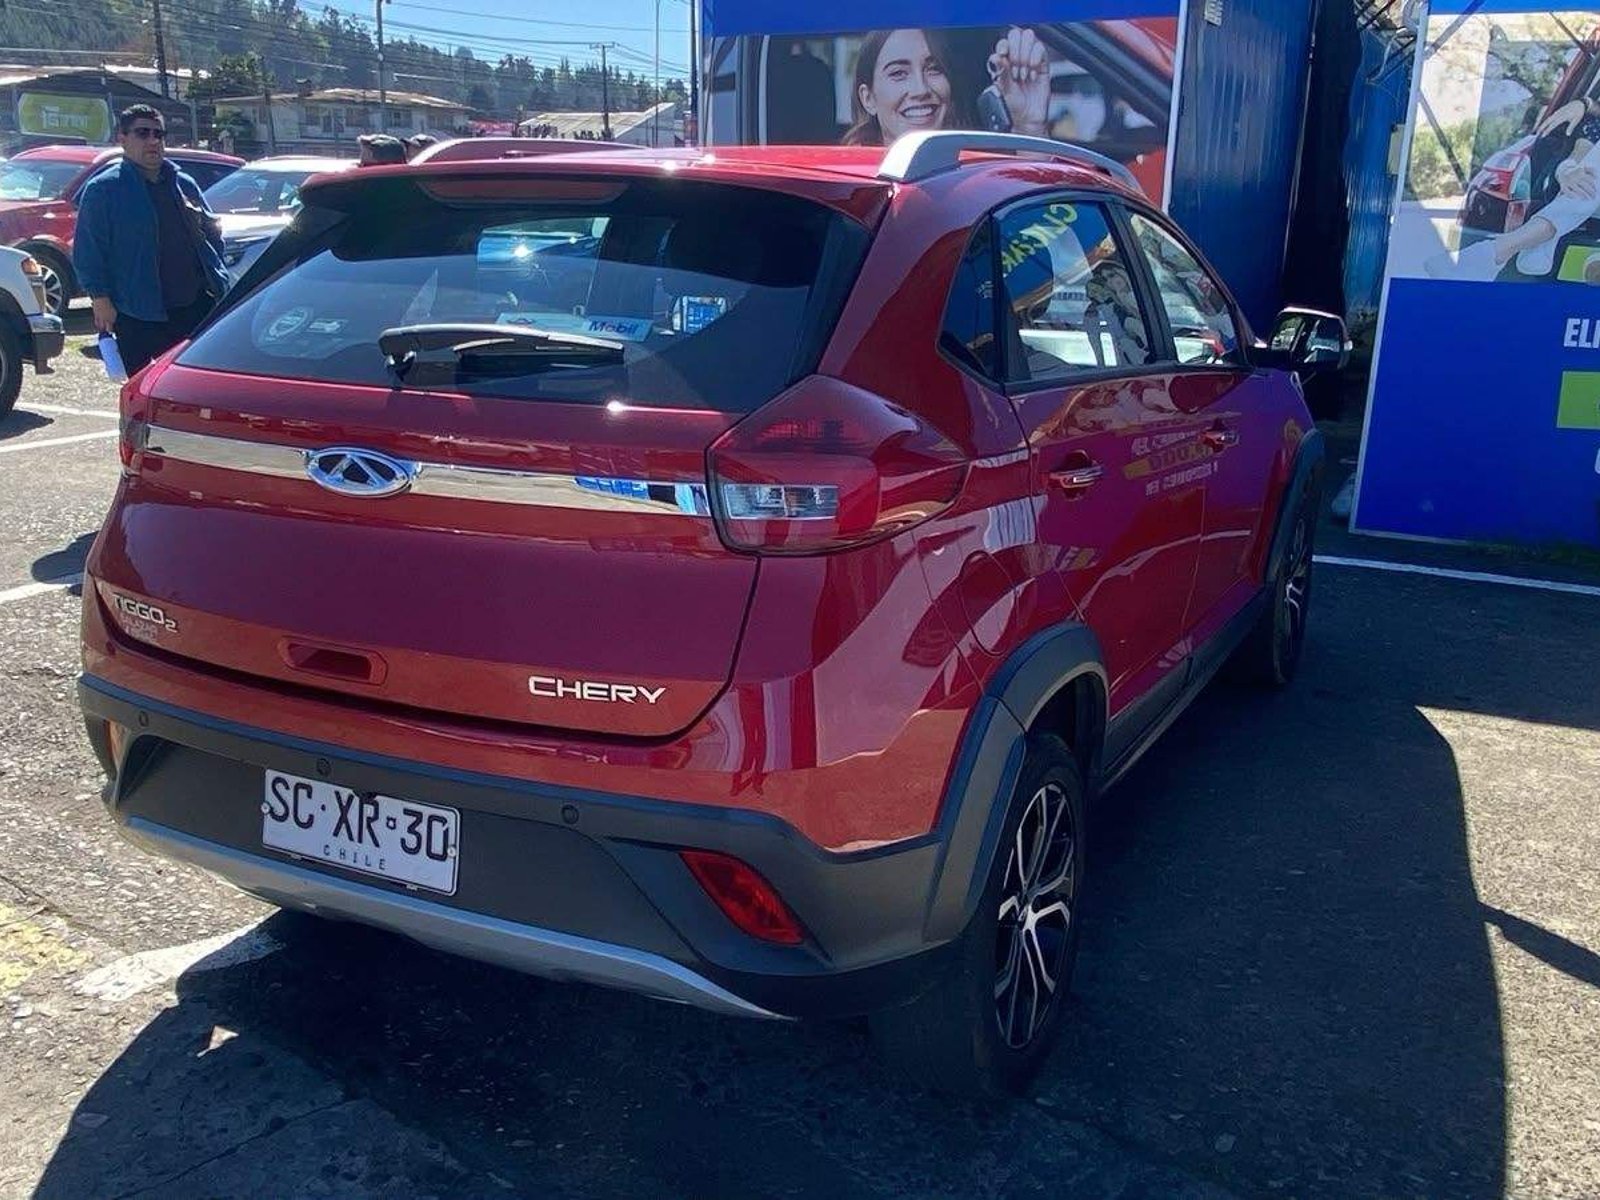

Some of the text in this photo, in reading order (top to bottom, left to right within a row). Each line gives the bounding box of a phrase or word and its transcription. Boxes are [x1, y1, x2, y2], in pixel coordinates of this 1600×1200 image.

[587, 320, 639, 335] Mobil
[528, 675, 666, 704] CHERY
[323, 844, 387, 871] CHILE
